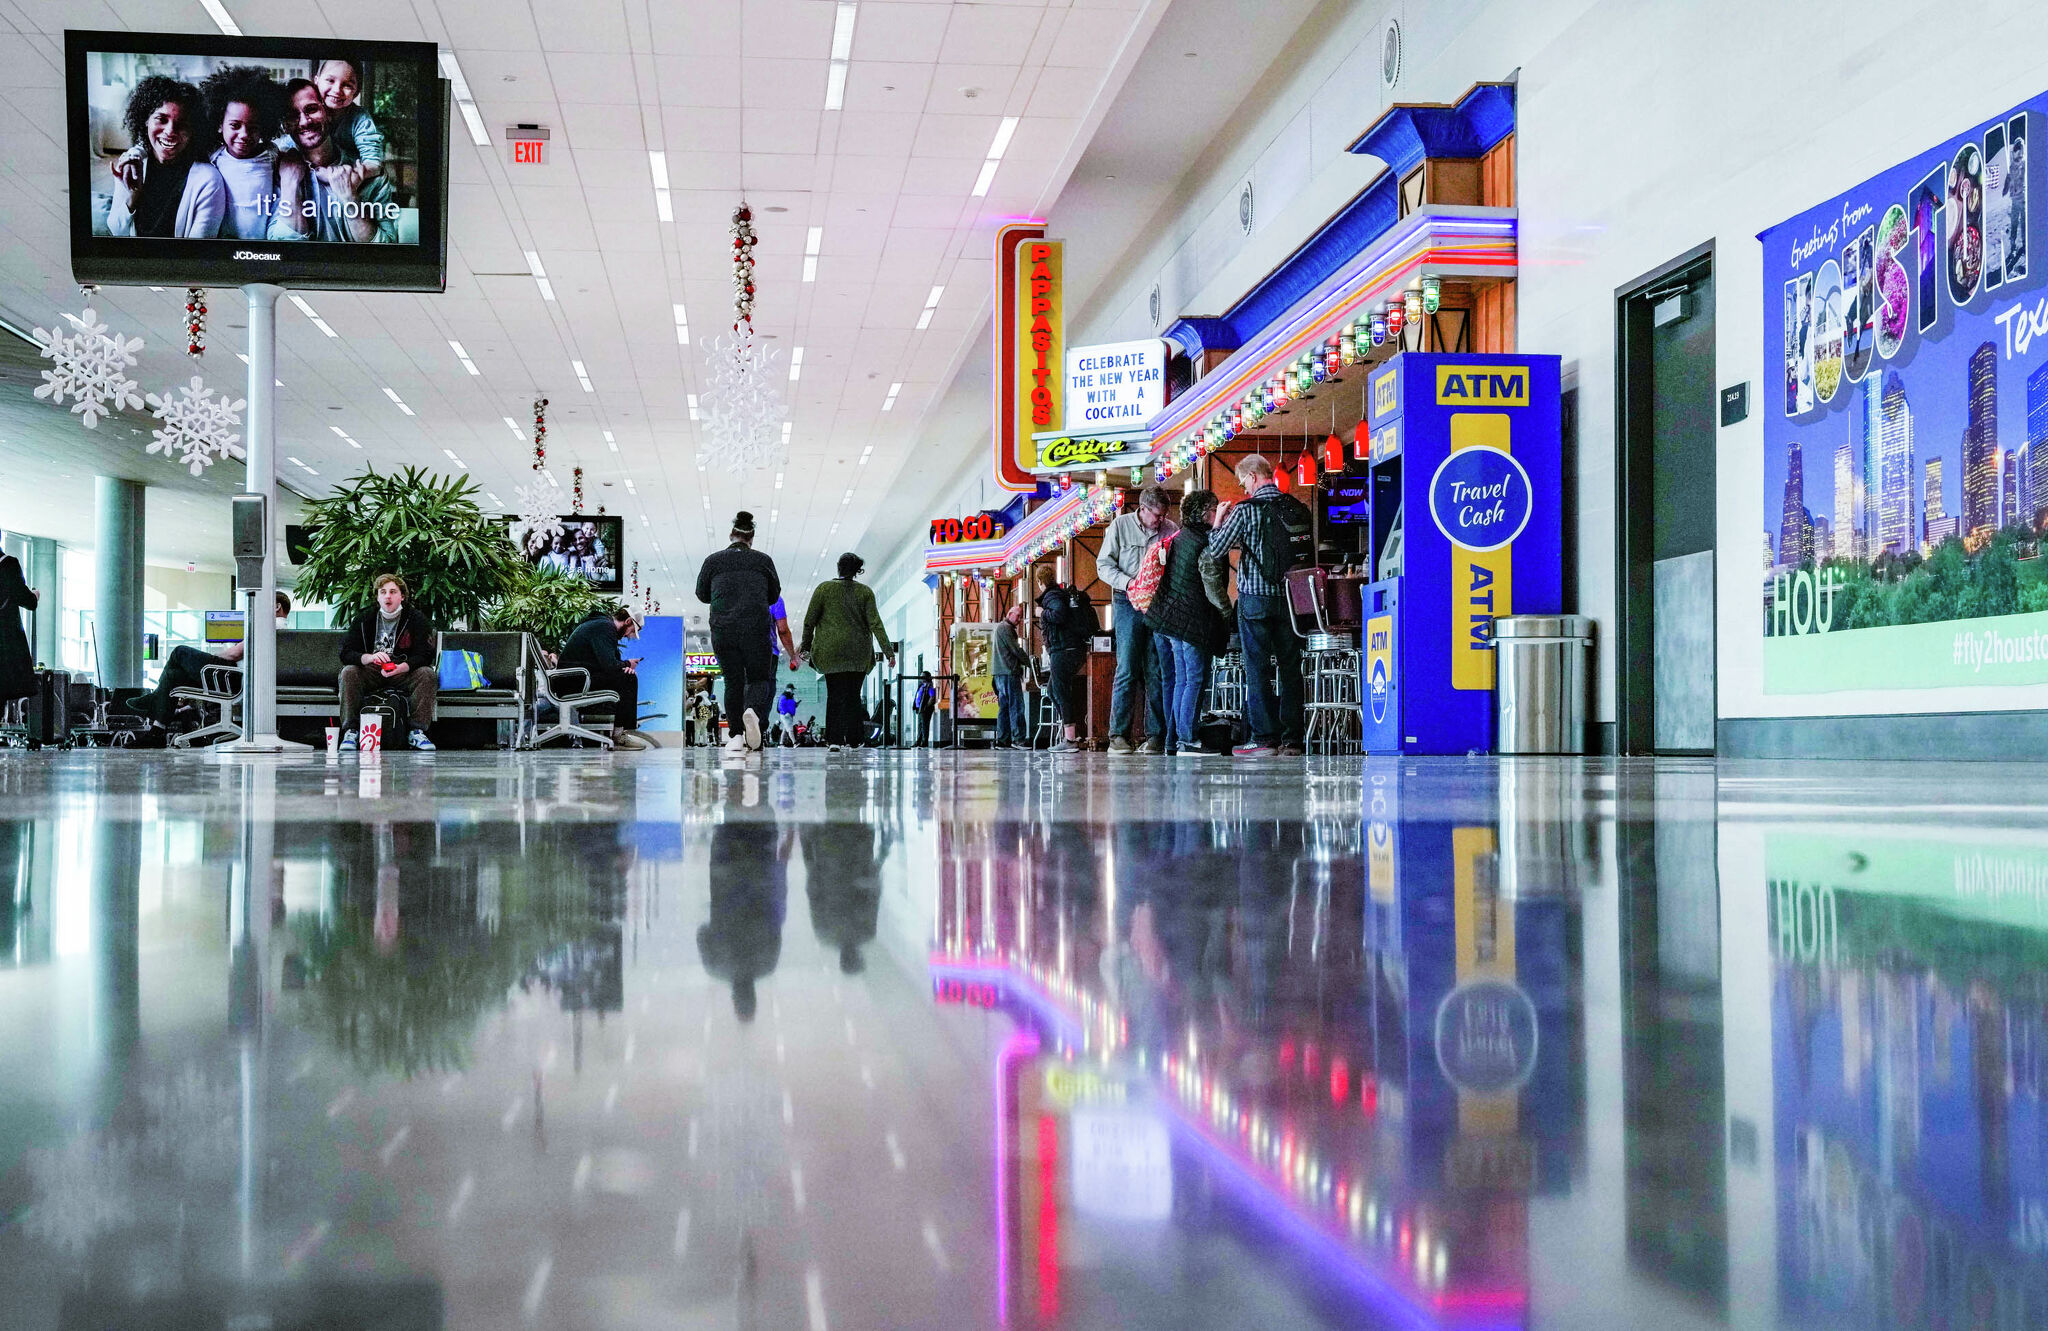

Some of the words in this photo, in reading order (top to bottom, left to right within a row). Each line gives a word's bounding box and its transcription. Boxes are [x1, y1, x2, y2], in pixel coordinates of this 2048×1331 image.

[515, 142, 543, 163] EXIT
[257, 194, 292, 217] It's
[302, 201, 317, 217] a
[327, 195, 400, 219] home
[1791, 219, 1839, 270] Greetings
[1842, 201, 1872, 238] from
[233, 251, 280, 261] JCDecaux
[1784, 111, 2029, 417] HOUSTON
[1031, 245, 1054, 425] PAPPASITO'S
[1079, 353, 1144, 371] CELEBRATE
[1072, 375, 1093, 388] THE
[1100, 372, 1122, 385] NEW
[1129, 369, 1159, 382] YEAR
[1442, 374, 1523, 398] ATM
[1087, 389, 1116, 403] WITH
[1137, 387, 1144, 399] A
[1377, 378, 1395, 410] ATM
[1085, 404, 1142, 420] COCKTAIL
[1041, 437, 1125, 467] Cantina
[1451, 474, 1511, 503] Travel
[1459, 500, 1505, 527] Cash
[931, 518, 959, 542] TO
[963, 514, 991, 540] GO
[1470, 563, 1493, 650] ATM
[1774, 567, 1833, 637] HOU
[1371, 631, 1387, 652] ATM
